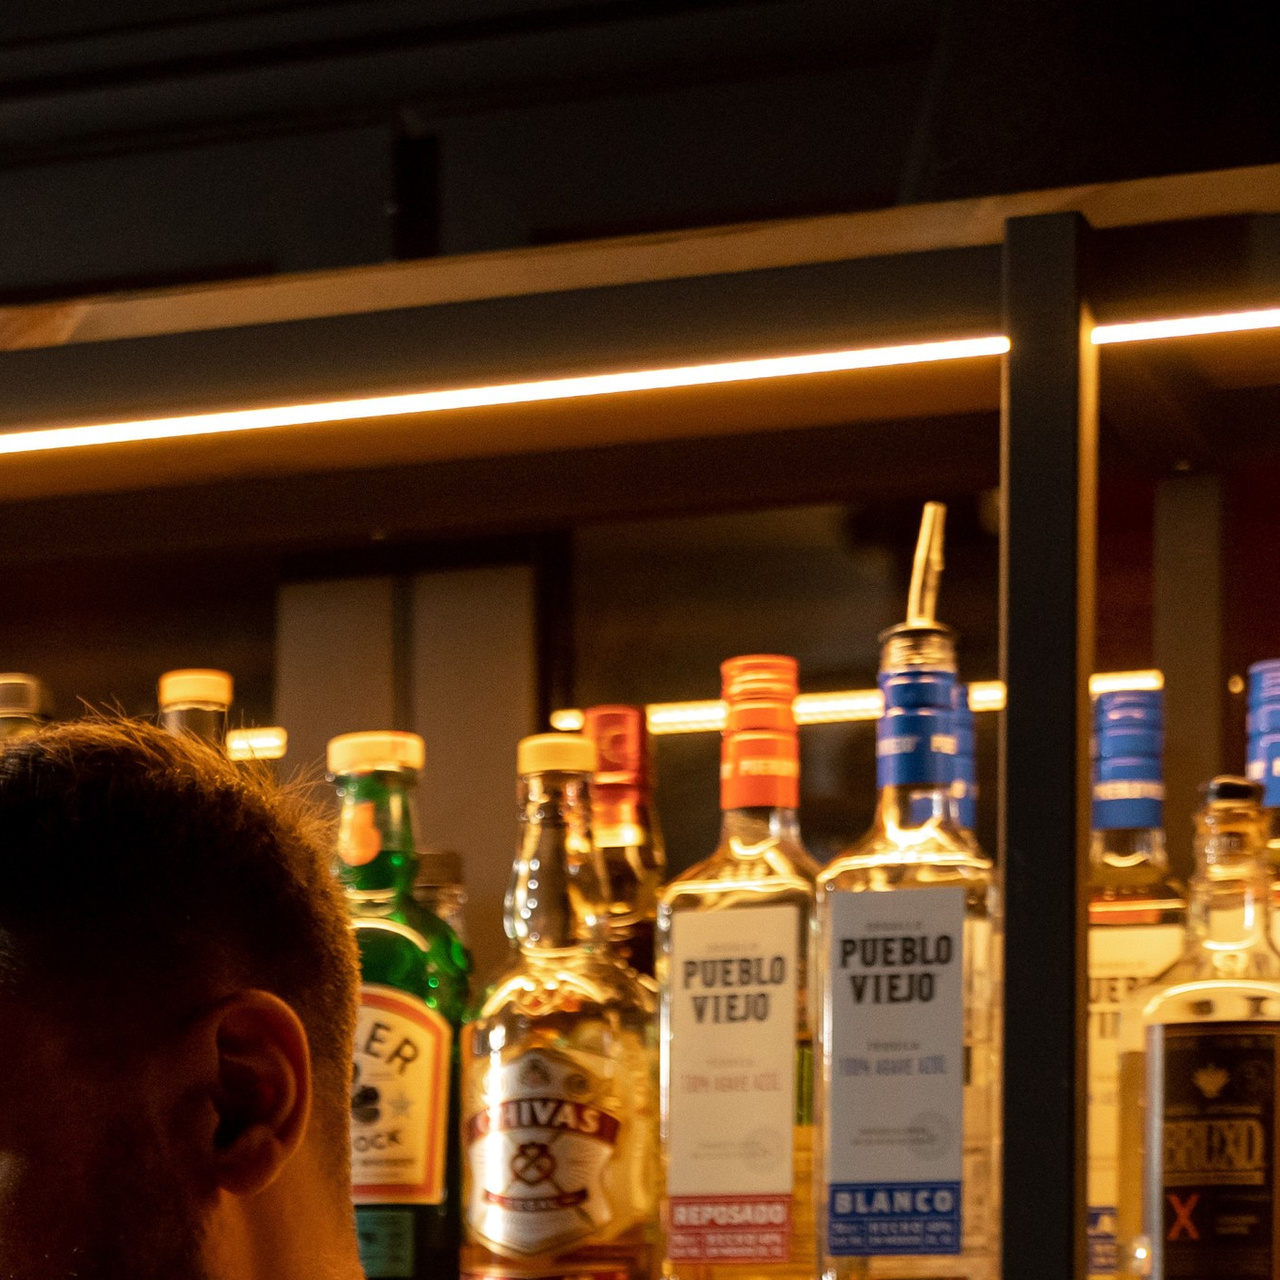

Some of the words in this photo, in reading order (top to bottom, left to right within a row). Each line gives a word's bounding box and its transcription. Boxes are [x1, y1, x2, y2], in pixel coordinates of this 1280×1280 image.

[839, 935, 953, 969] PUEBLO
[682, 956, 787, 989] PUEBLO
[850, 973, 936, 1005] VIEJO
[690, 993, 769, 1024] VIEJO
[477, 1100, 601, 1134] CHIVAS
[673, 1202, 786, 1226] REPOSADO
[834, 1190, 954, 1214] BLANCO
